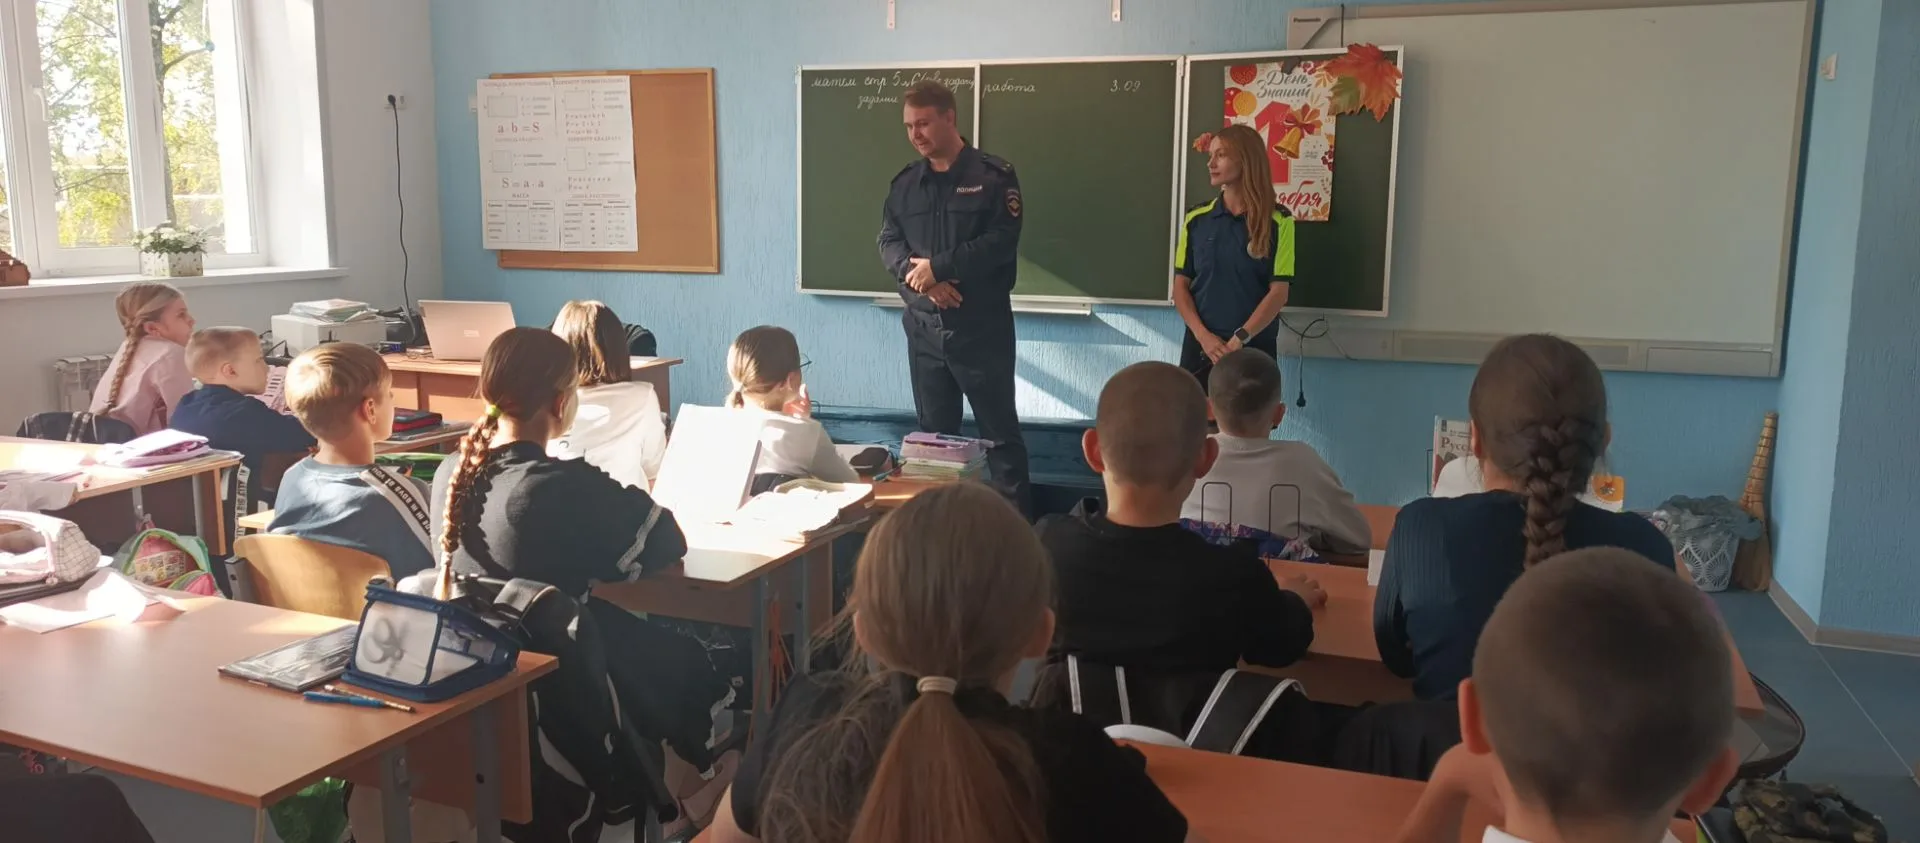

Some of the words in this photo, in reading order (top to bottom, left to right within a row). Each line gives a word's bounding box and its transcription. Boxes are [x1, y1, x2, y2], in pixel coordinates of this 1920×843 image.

[1266, 69, 1310, 86] День
[983, 79, 1036, 98] работа
[1256, 79, 1312, 98] Знаний
[1254, 100, 1291, 184] 1
[1278, 180, 1322, 212] ября
[1440, 436, 1469, 452] Русс
